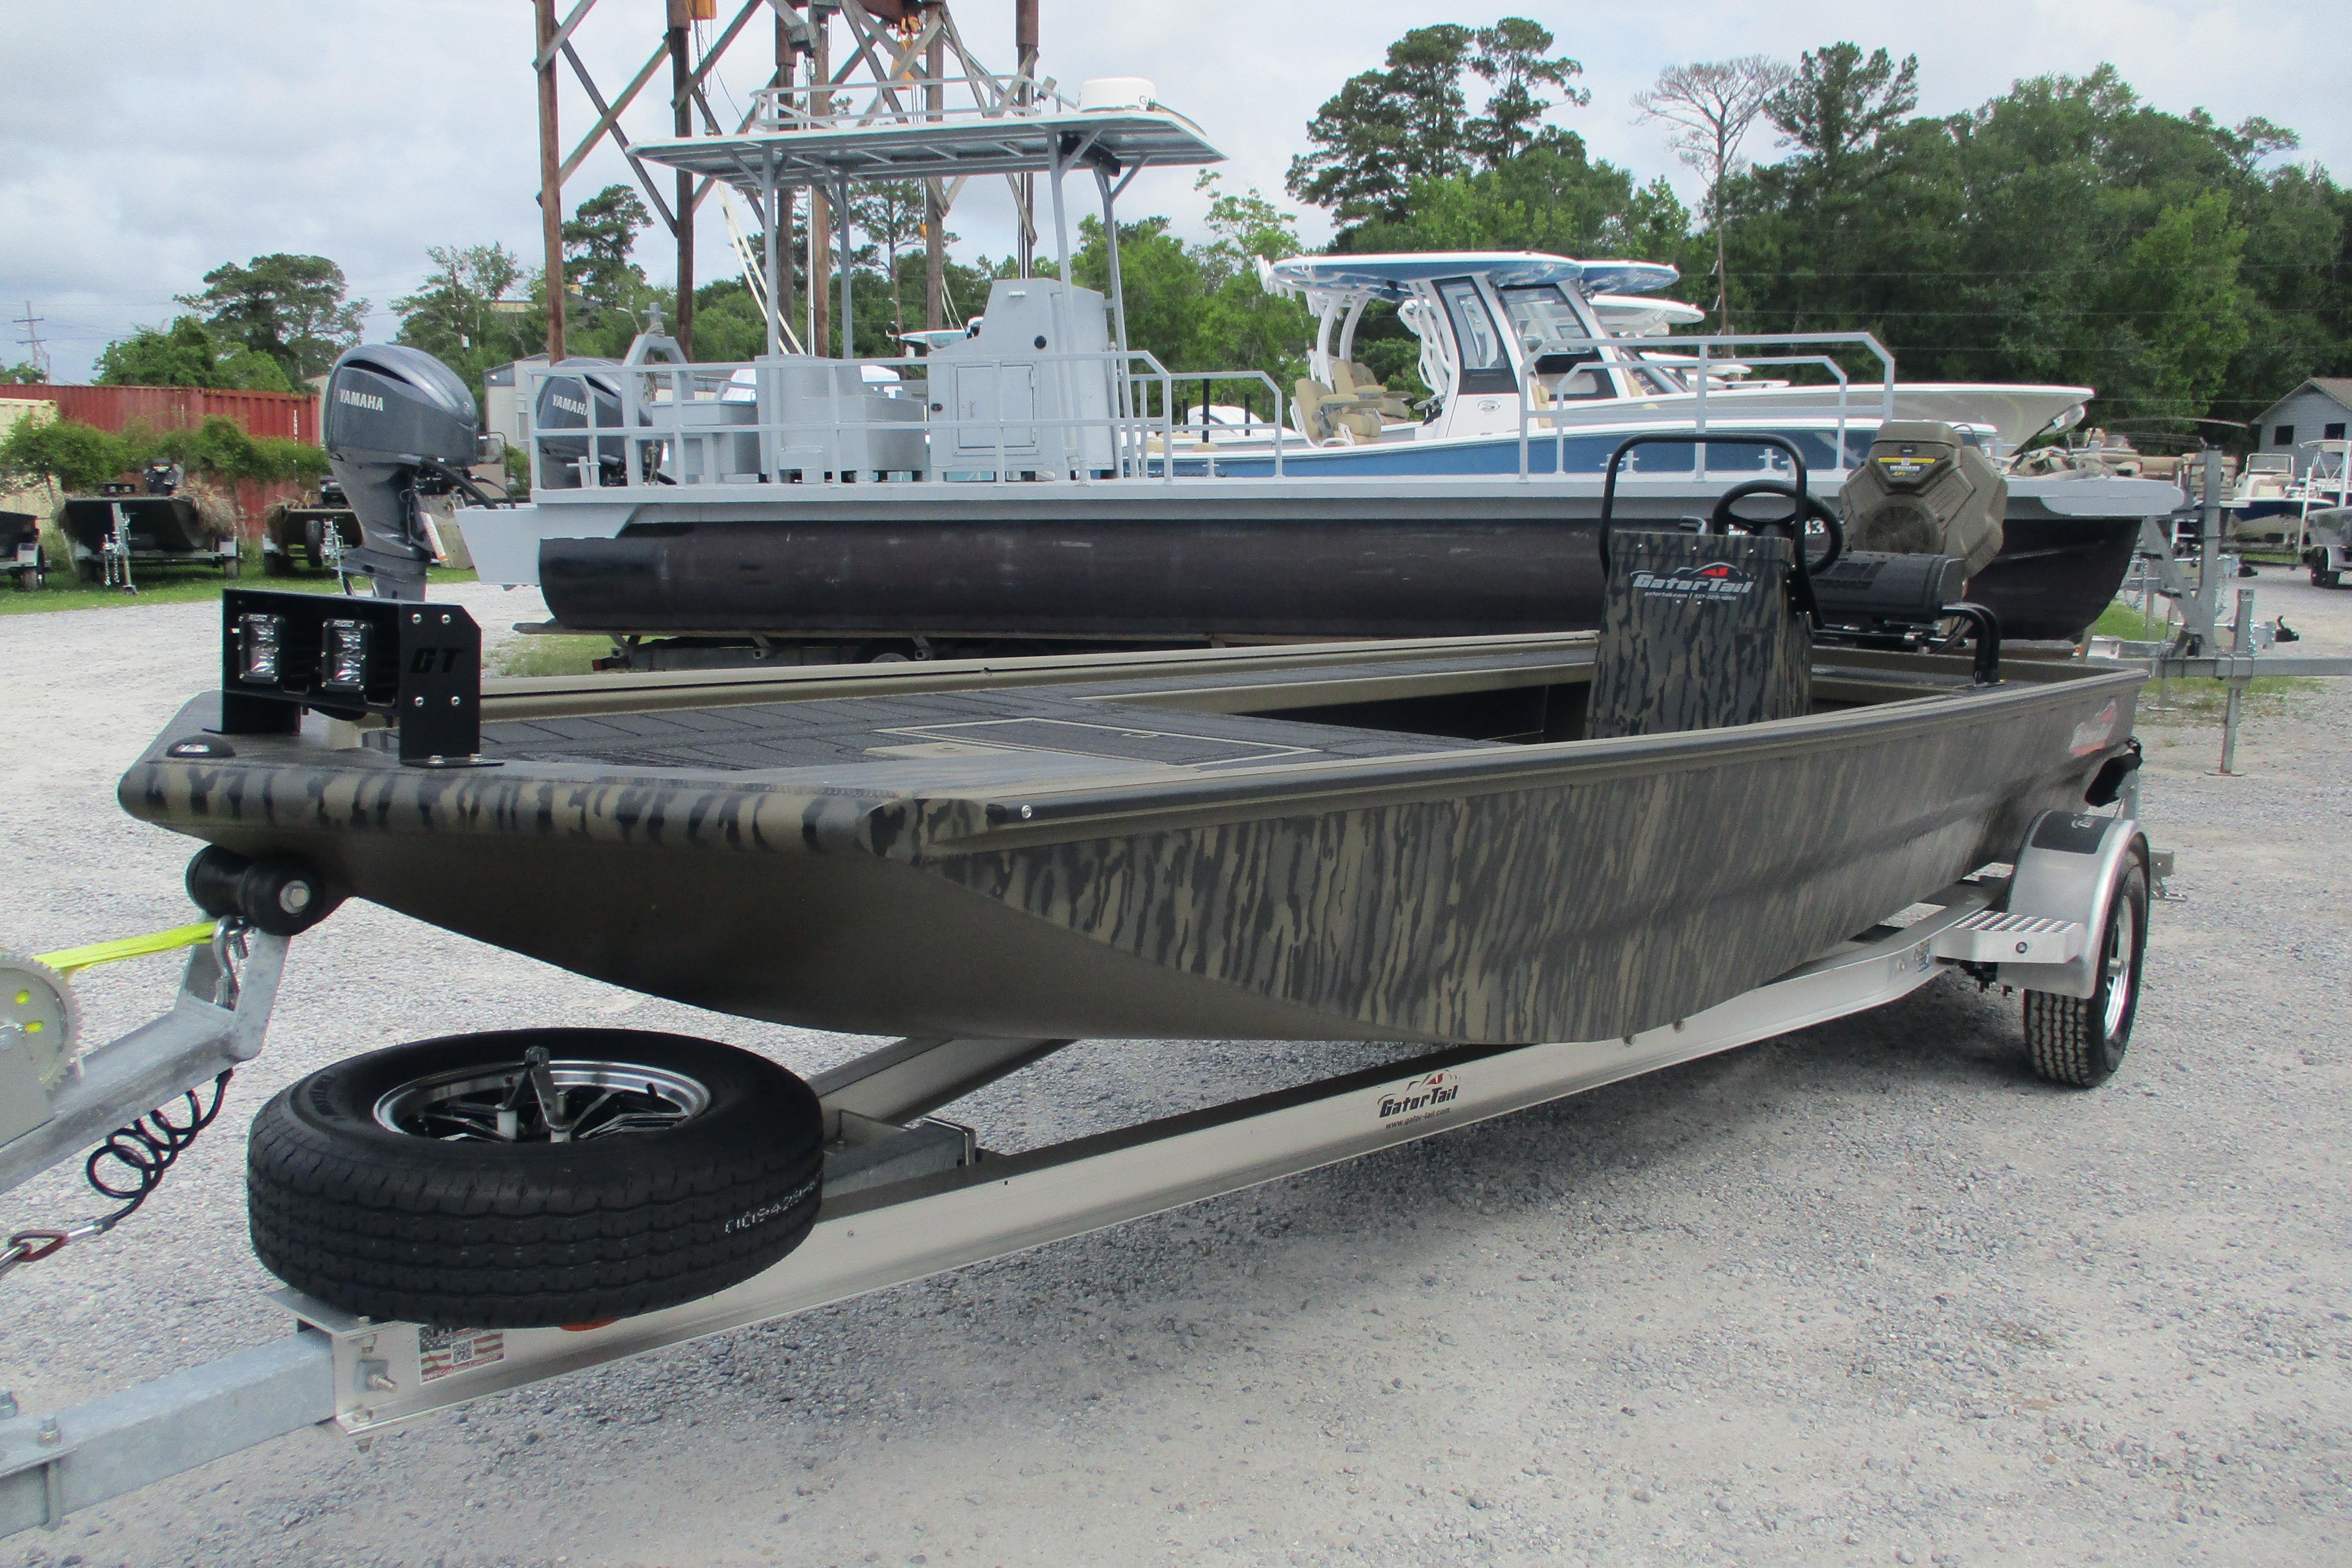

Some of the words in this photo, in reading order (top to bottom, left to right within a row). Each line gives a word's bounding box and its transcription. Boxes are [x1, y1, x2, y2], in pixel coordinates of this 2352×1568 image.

[340, 388, 383, 411] YAMAHA
[552, 393, 586, 416] YAMAH
[410, 648, 462, 673] GT
[1379, 1085, 1459, 1118] GatorTail
[1386, 1107, 1450, 1129] www.gator-tail.com
